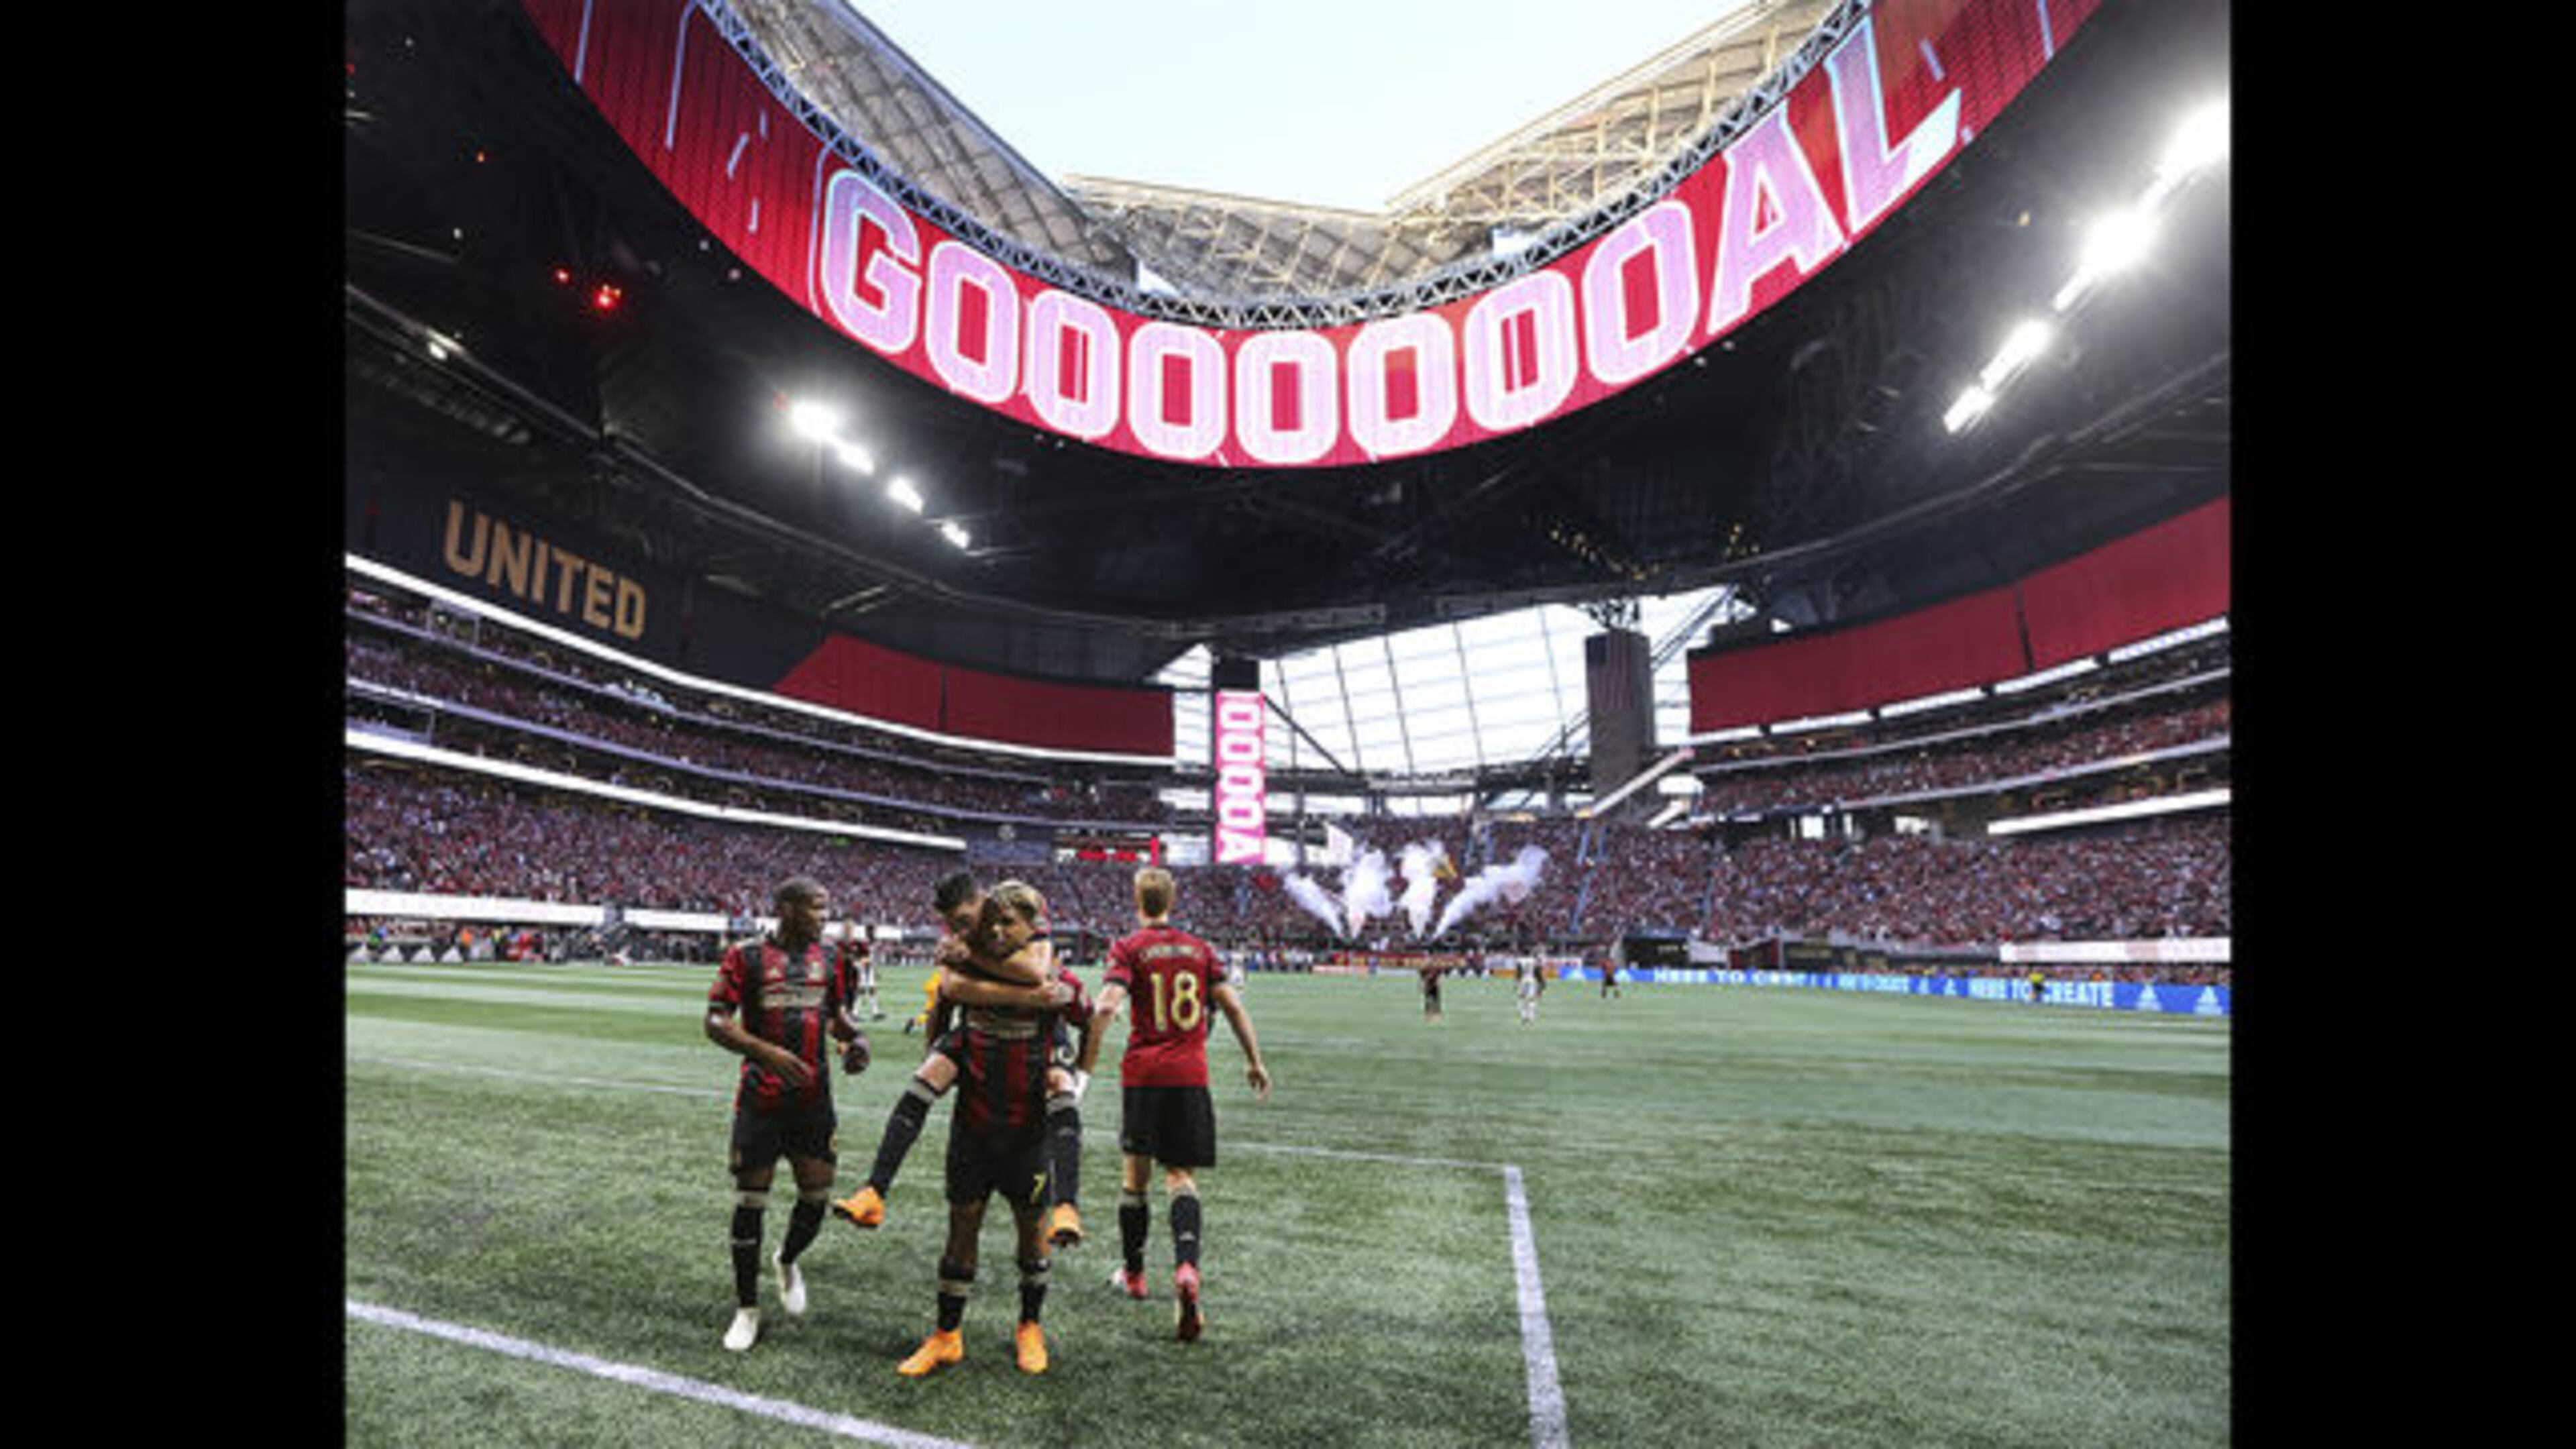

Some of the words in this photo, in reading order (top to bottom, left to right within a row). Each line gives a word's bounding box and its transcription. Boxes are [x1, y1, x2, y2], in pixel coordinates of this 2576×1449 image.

[820, 17, 1962, 464] GOOOOOOOAL
[444, 500, 647, 640] UNITED
[1150, 970, 1200, 1032] 18
[2043, 981, 2114, 1008] CREATE
[1032, 1173, 1046, 1203] 7
